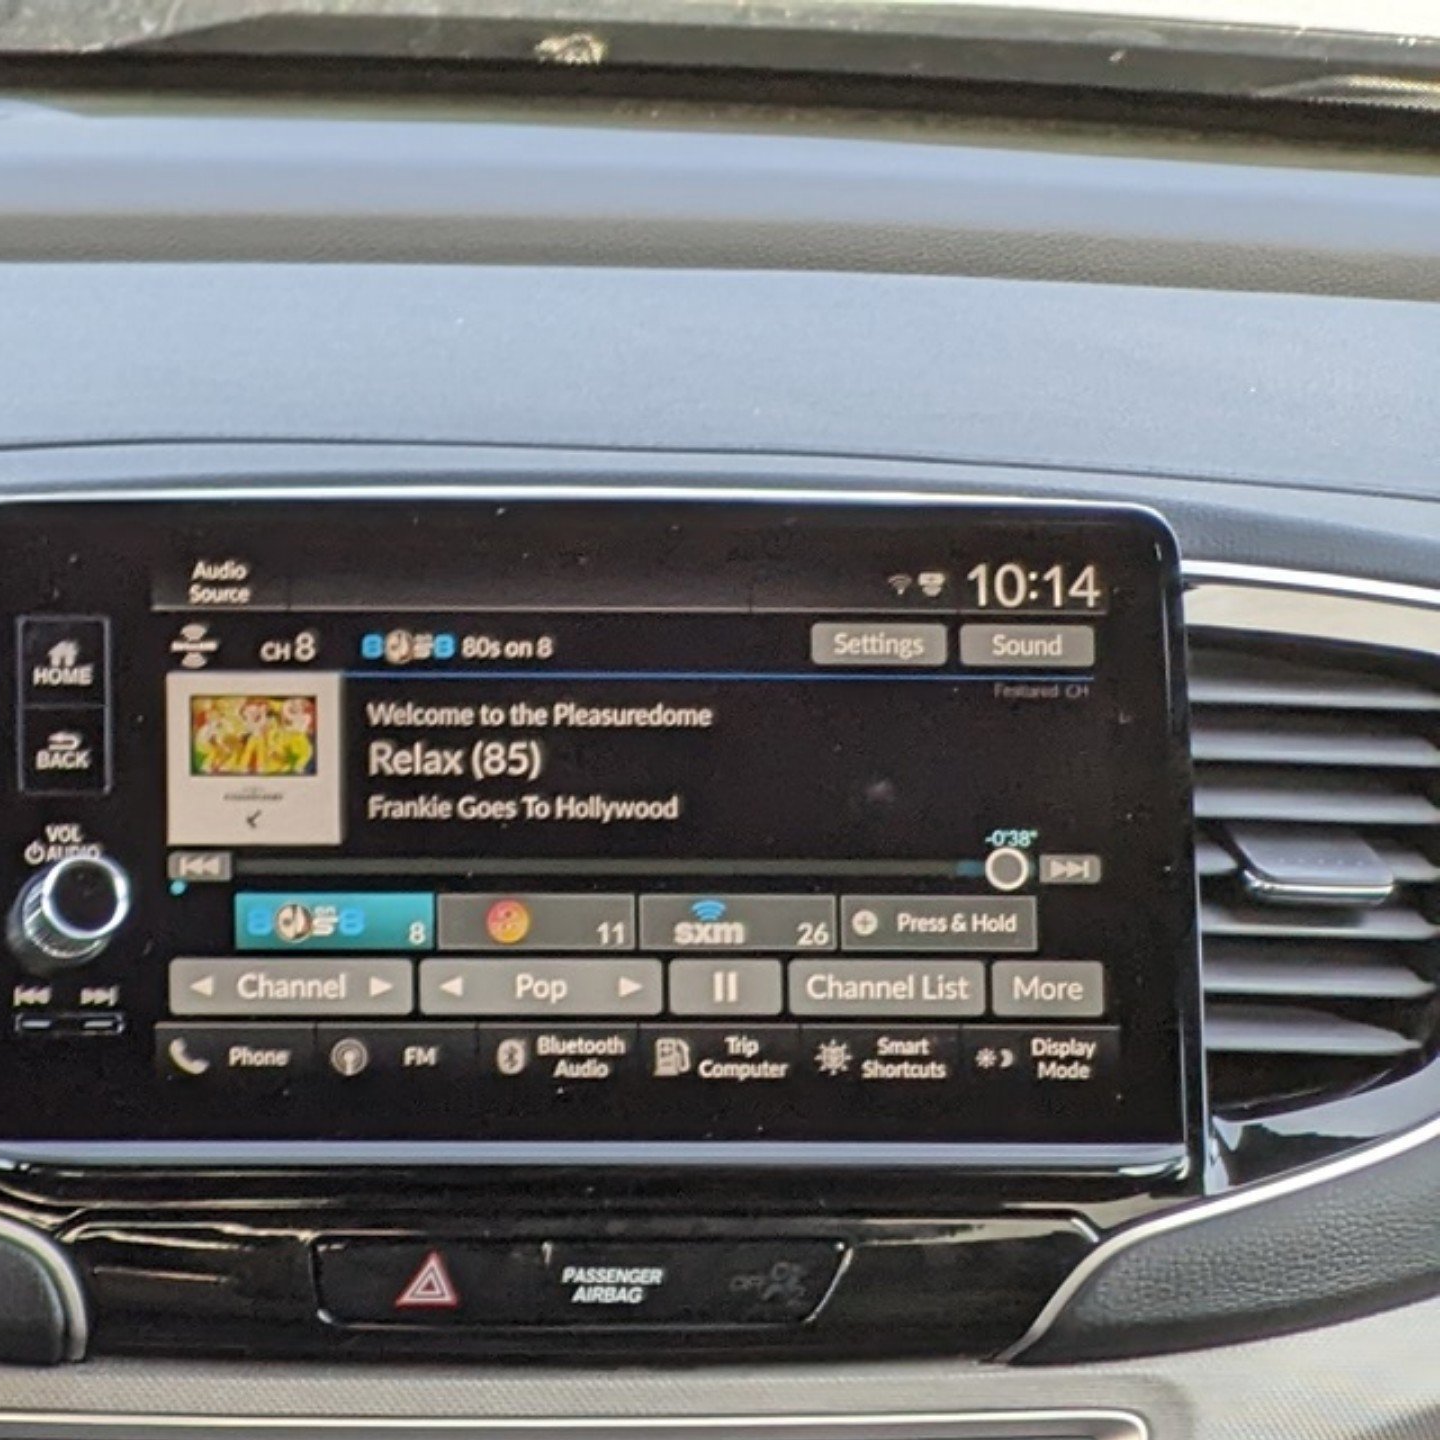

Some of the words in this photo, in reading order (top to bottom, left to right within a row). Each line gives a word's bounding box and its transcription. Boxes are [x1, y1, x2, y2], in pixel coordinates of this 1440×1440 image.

[193, 560, 248, 581] Audio
[189, 584, 251, 604] Source
[967, 562, 1101, 608] 10:14
[260, 640, 291, 662] CH
[294, 631, 317, 662] 8
[462, 635, 500, 659] 80s
[504, 640, 531, 659] on
[537, 636, 554, 659] 8
[832, 630, 924, 659] Settings
[991, 632, 1063, 658] Sound
[33, 667, 92, 687] HOME
[366, 702, 474, 727] Welcome
[480, 705, 504, 727] to
[509, 702, 548, 727] the
[553, 702, 713, 729] Pleasuredome
[36, 749, 90, 770] BACK
[369, 744, 463, 776] Relax
[471, 743, 542, 780] (85)
[368, 795, 451, 820] Frankie
[456, 797, 517, 820] Goes
[523, 797, 551, 820] To
[556, 793, 679, 823] Hollywood
[45, 823, 82, 843] VOL
[408, 921, 426, 946] 8
[596, 924, 626, 946] 11
[673, 920, 746, 946] sxm
[796, 923, 829, 946] 26
[897, 914, 948, 934] Press
[951, 914, 967, 934] &
[971, 913, 1018, 934] Hold
[237, 972, 346, 1000] Channel
[516, 974, 568, 1004] Pop
[806, 973, 917, 1000] Channel
[922, 974, 970, 1000] List
[1013, 976, 1084, 1001] More
[229, 1046, 289, 1068] Phone
[404, 1046, 439, 1066] FM
[536, 1035, 626, 1057] Bluetooth
[723, 1035, 759, 1060] Trip
[876, 1036, 929, 1057] Smart
[1031, 1036, 1097, 1061] Display
[554, 1058, 611, 1079] Audio
[698, 1057, 788, 1081] Computer
[861, 1058, 947, 1079] Shortcuts
[1038, 1059, 1090, 1080] Mode
[561, 1266, 664, 1285] PASSENGER
[571, 1285, 644, 1305] AIRBAG
